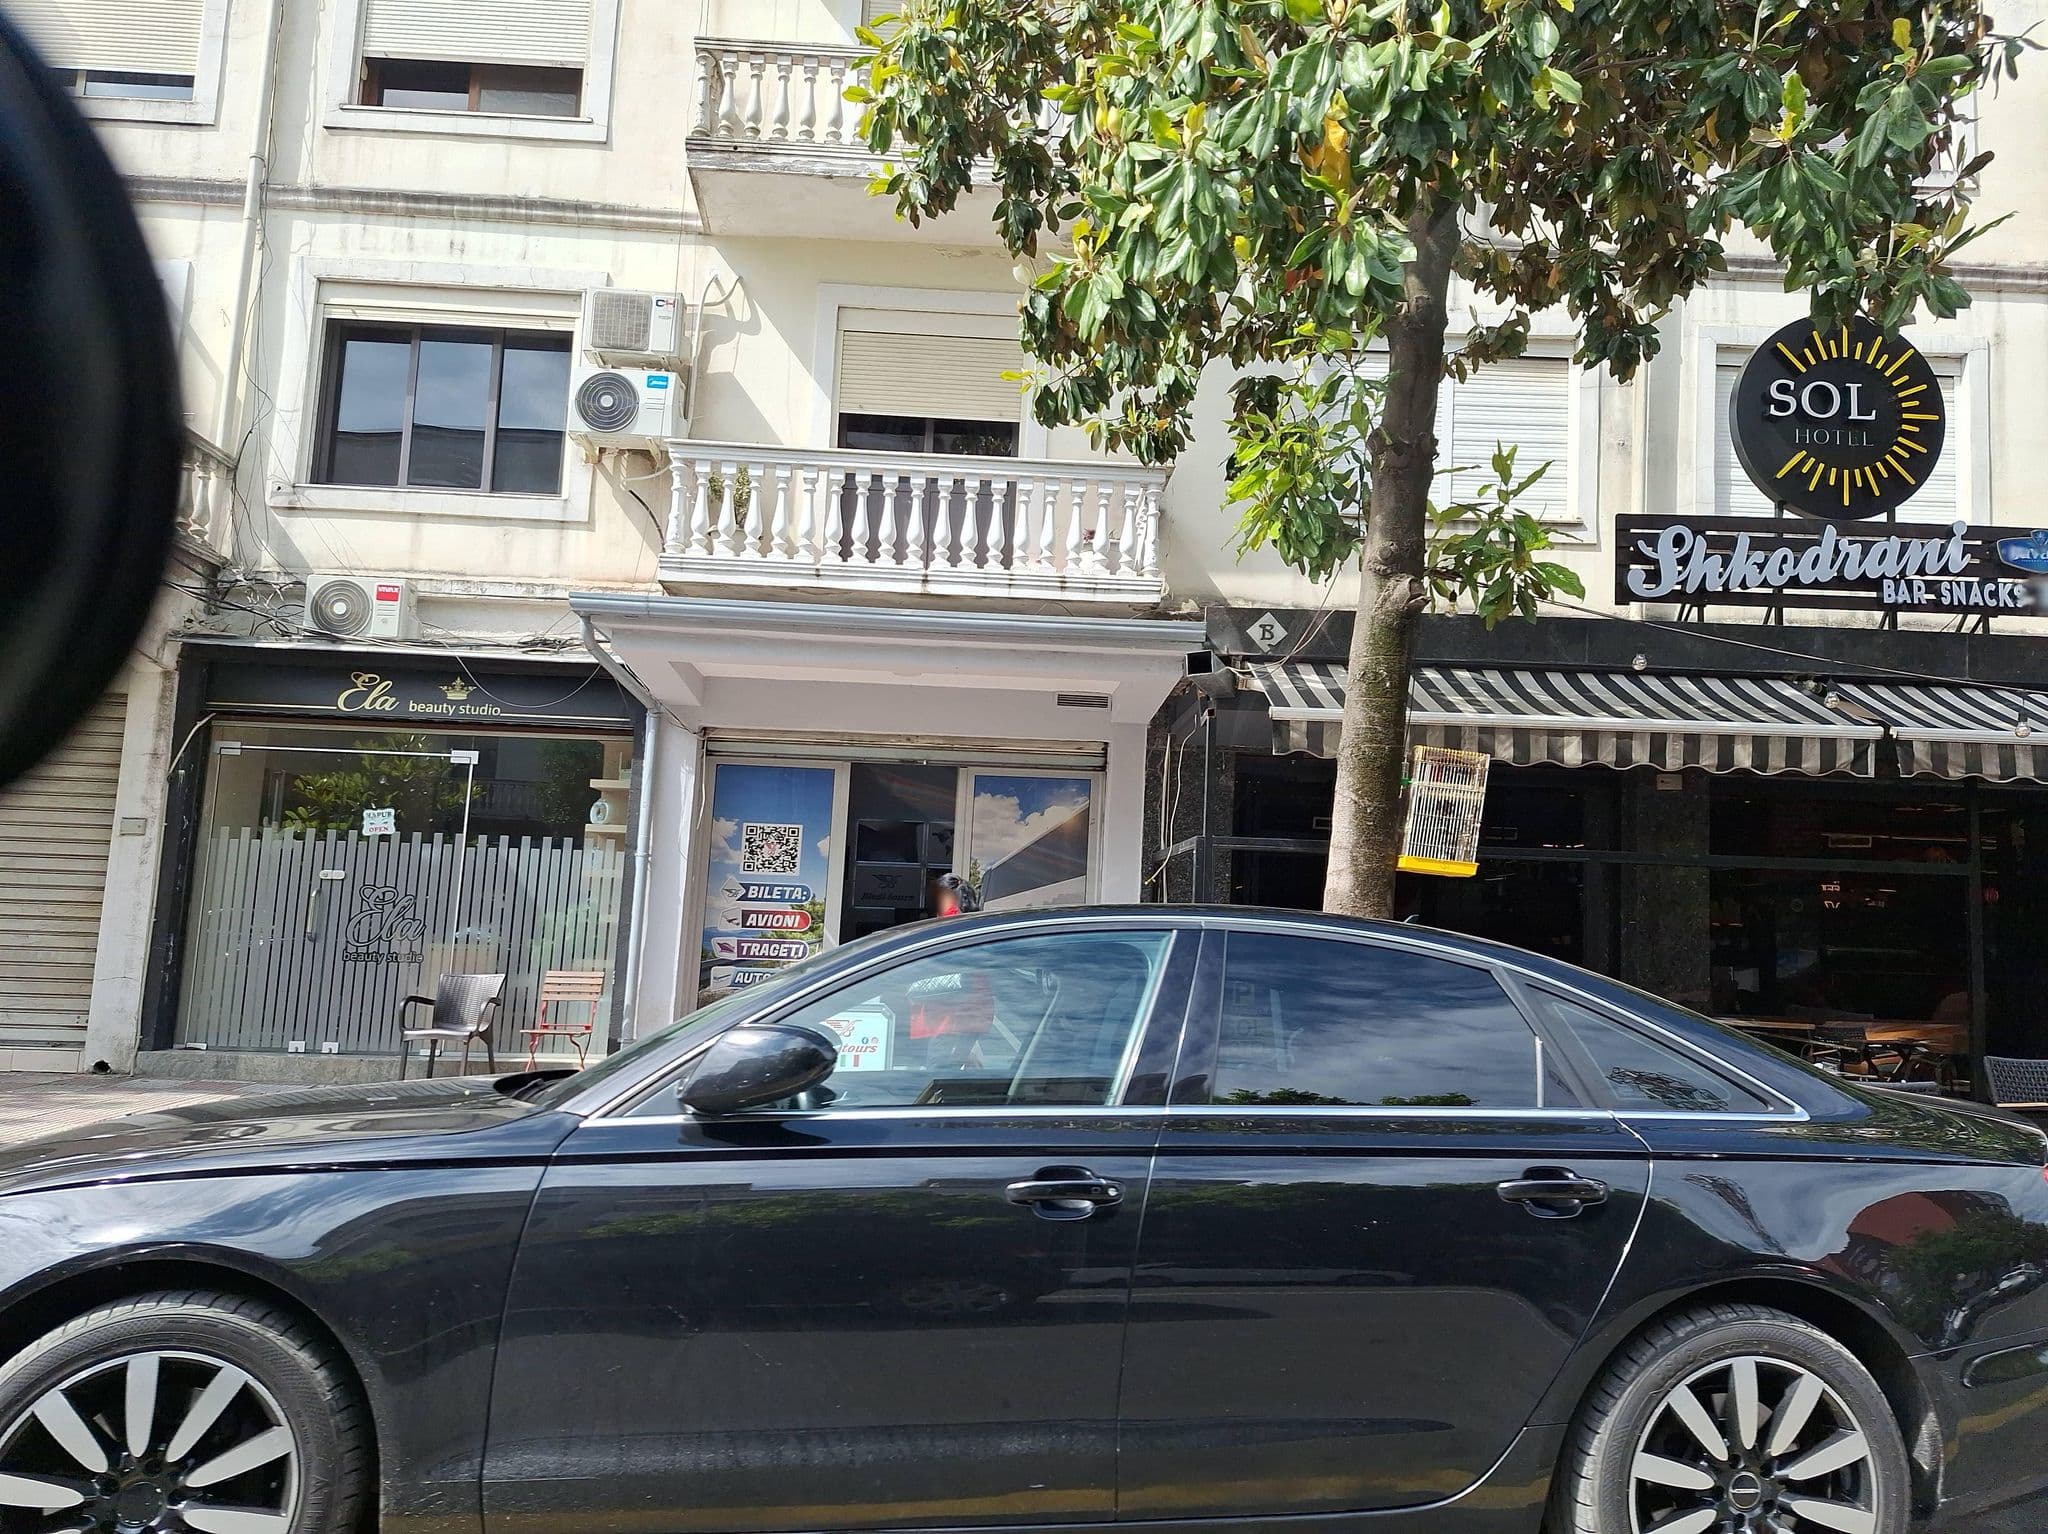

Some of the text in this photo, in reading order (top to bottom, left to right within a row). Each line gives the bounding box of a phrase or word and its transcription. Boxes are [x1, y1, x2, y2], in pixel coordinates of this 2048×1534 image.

[1769, 379, 1877, 421] SOL
[1795, 428, 1874, 447] HOTEL
[1627, 520, 1971, 598] Shkodrani
[1883, 579, 1927, 605] BAR
[1259, 624, 1275, 640] B
[337, 671, 501, 717] Ela beauty studio
[747, 885, 808, 901] BILETA:
[345, 884, 427, 948] Ela
[746, 913, 801, 928] AVIONI
[343, 949, 425, 966] beauty studio
